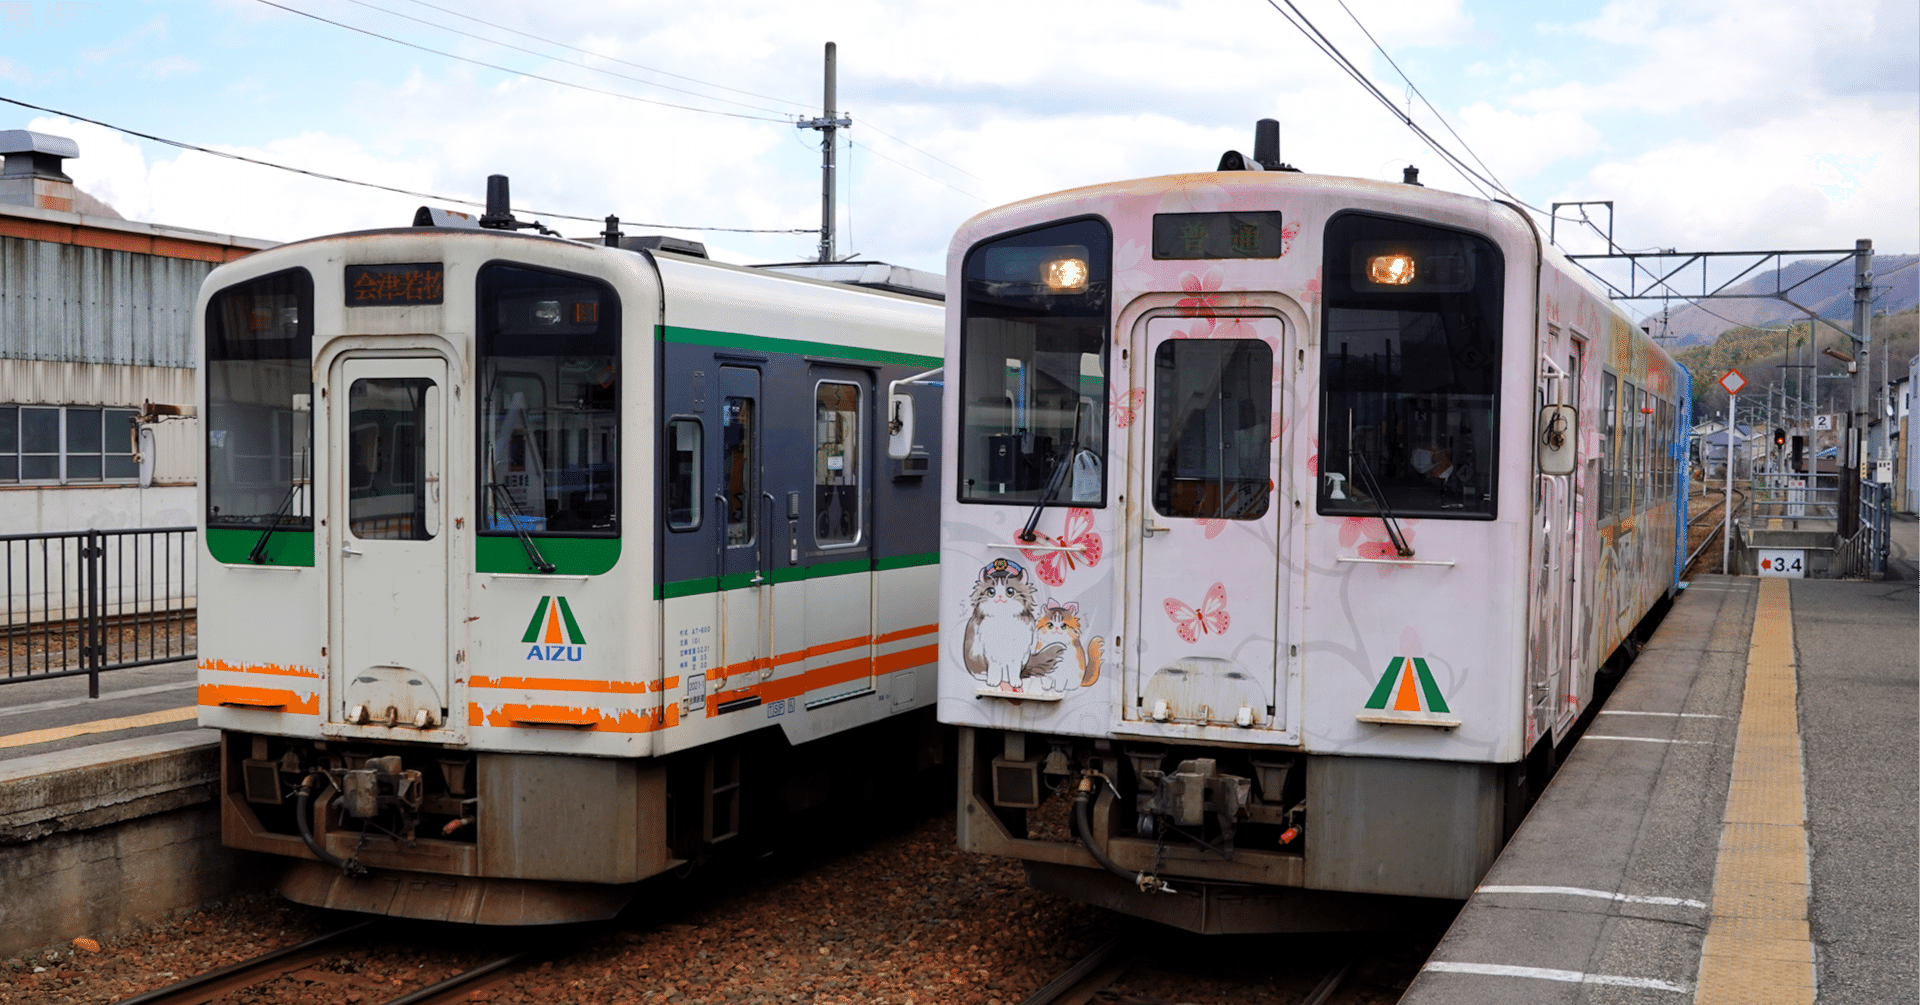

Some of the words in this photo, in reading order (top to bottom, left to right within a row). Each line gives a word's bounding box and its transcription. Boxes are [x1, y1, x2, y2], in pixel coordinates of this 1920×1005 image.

[1817, 416, 1827, 425] 2
[1773, 557, 1803, 572] 3.4
[526, 645, 582, 662] AIZU
[768, 702, 785, 716] TSP
